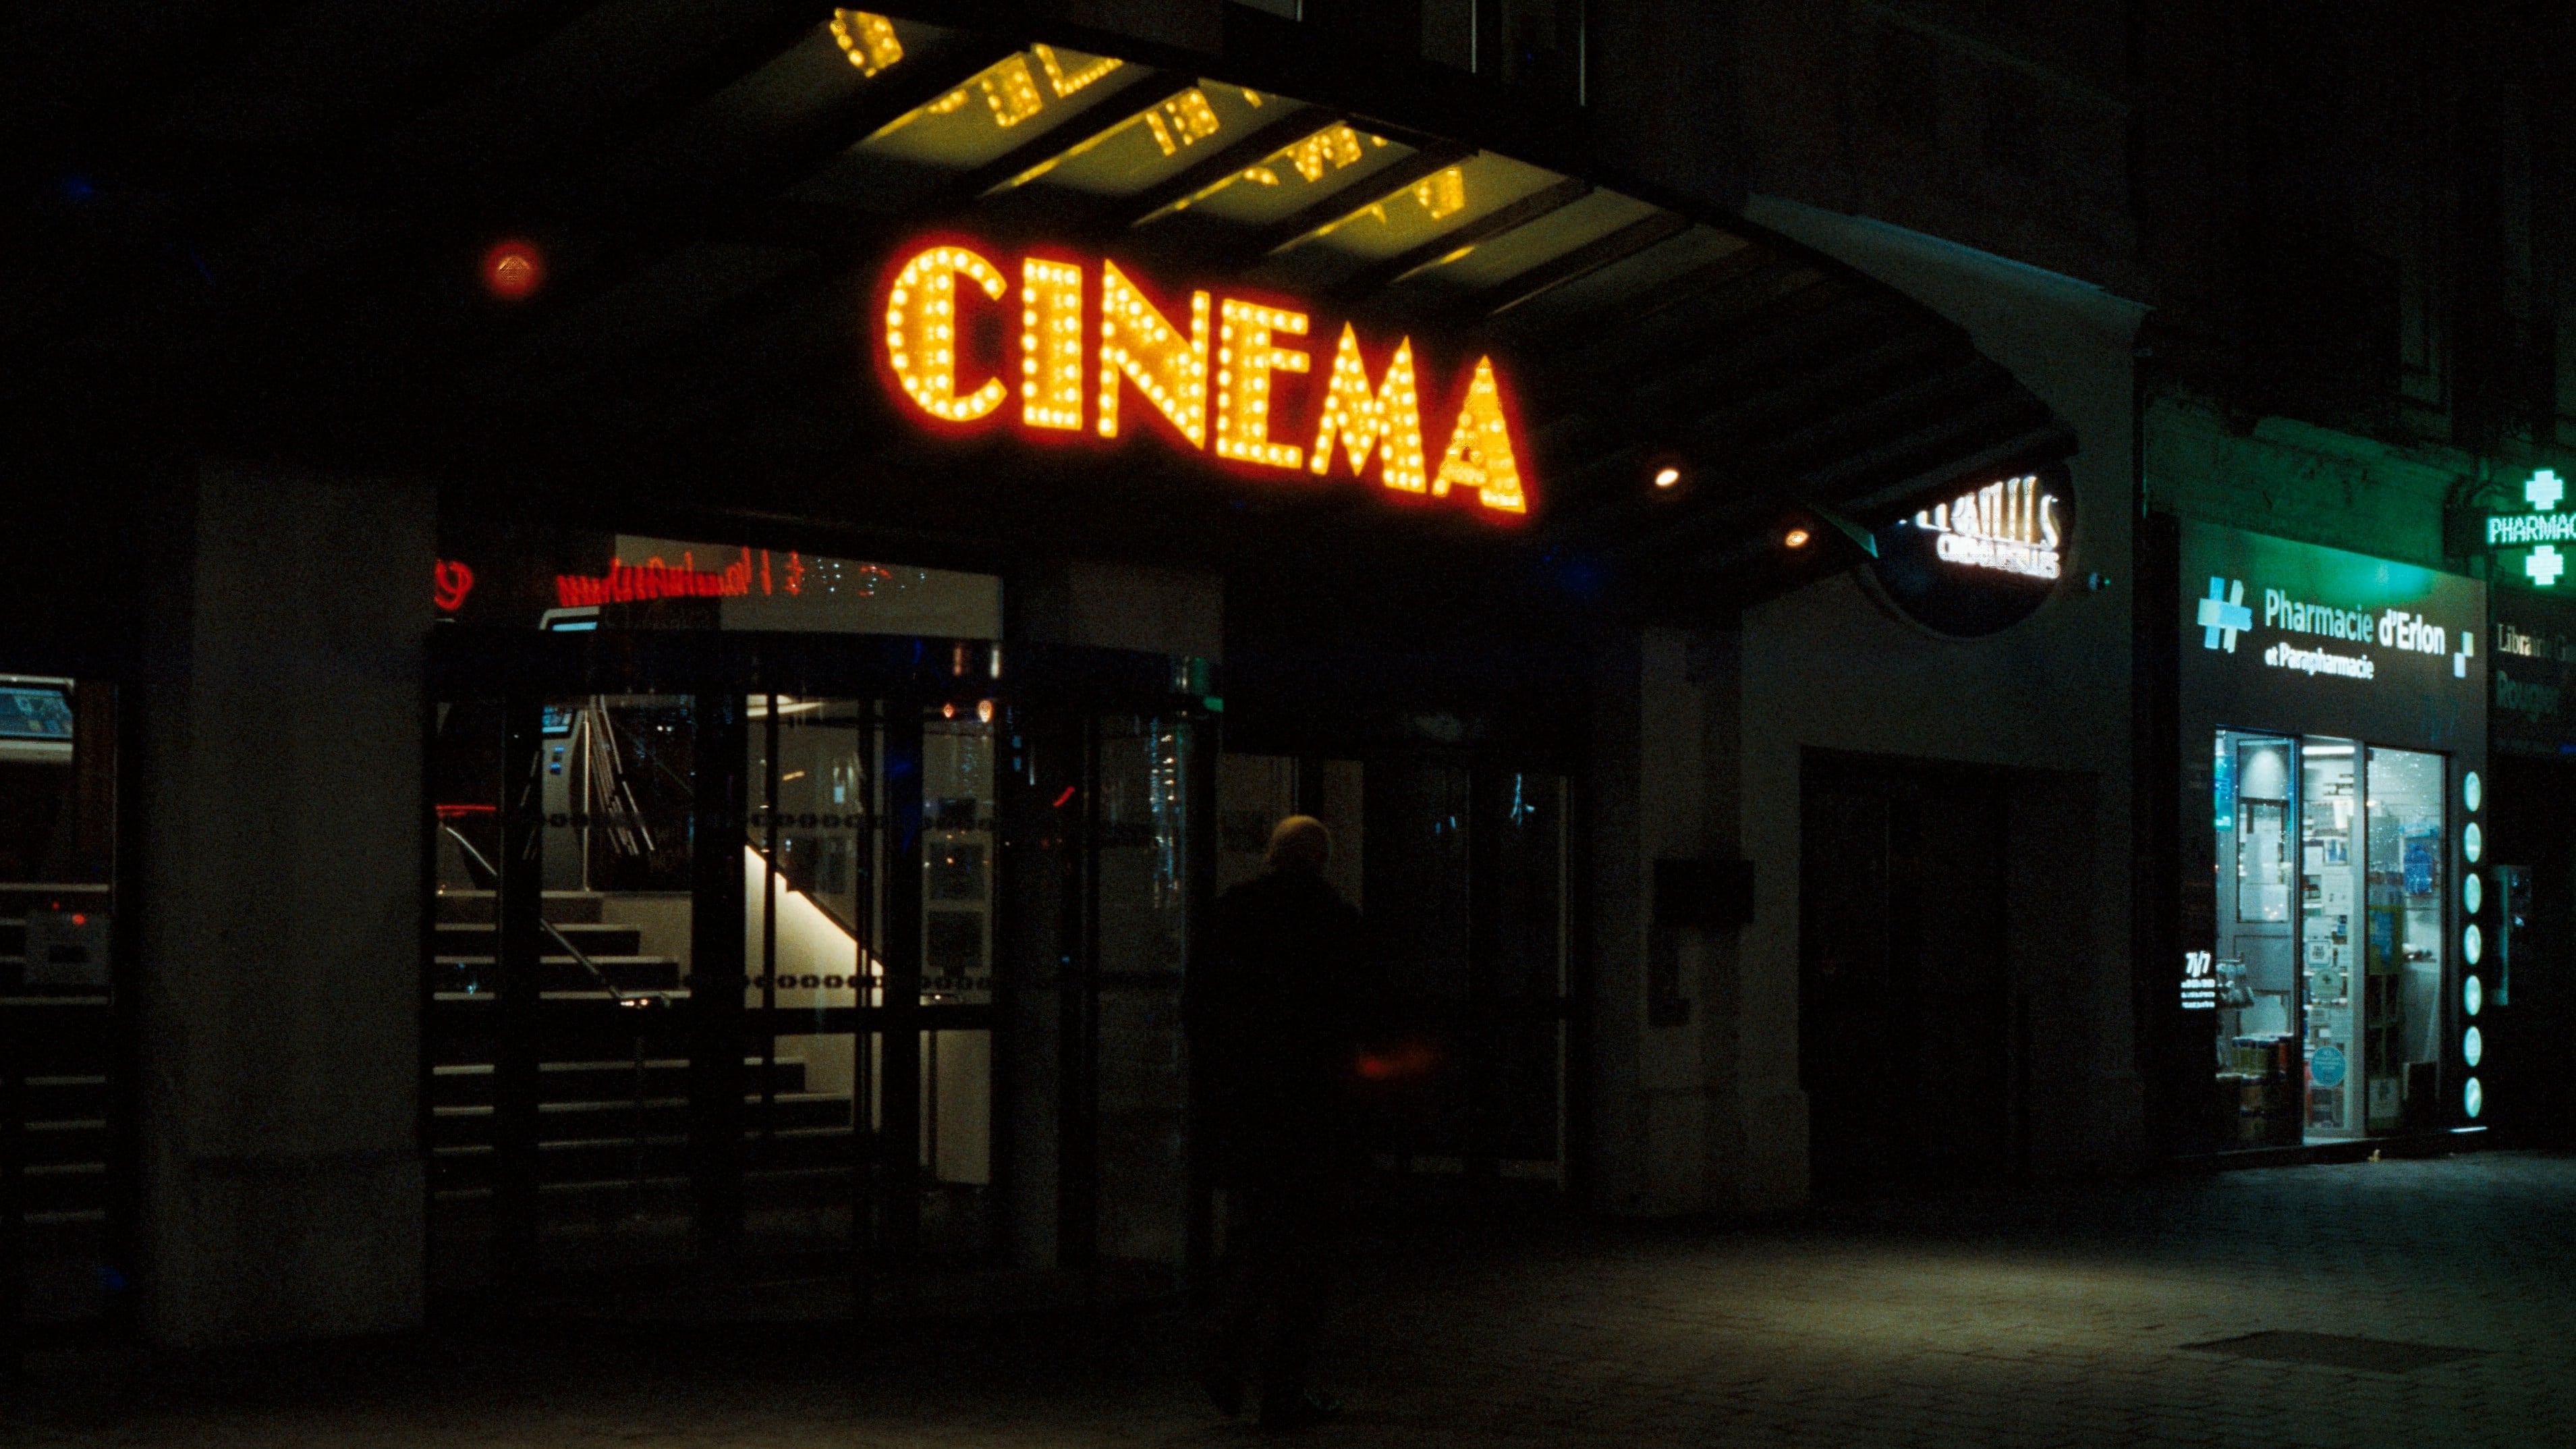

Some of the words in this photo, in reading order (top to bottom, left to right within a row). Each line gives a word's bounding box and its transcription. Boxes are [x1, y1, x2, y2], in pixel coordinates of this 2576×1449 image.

[885, 244, 1528, 515] CINEMA
[2264, 588, 2374, 643] Pharmacie
[2378, 608, 2446, 655] d'Erlon
[2264, 646, 2278, 666] et
[2278, 641, 2374, 680] Parapharmacie
